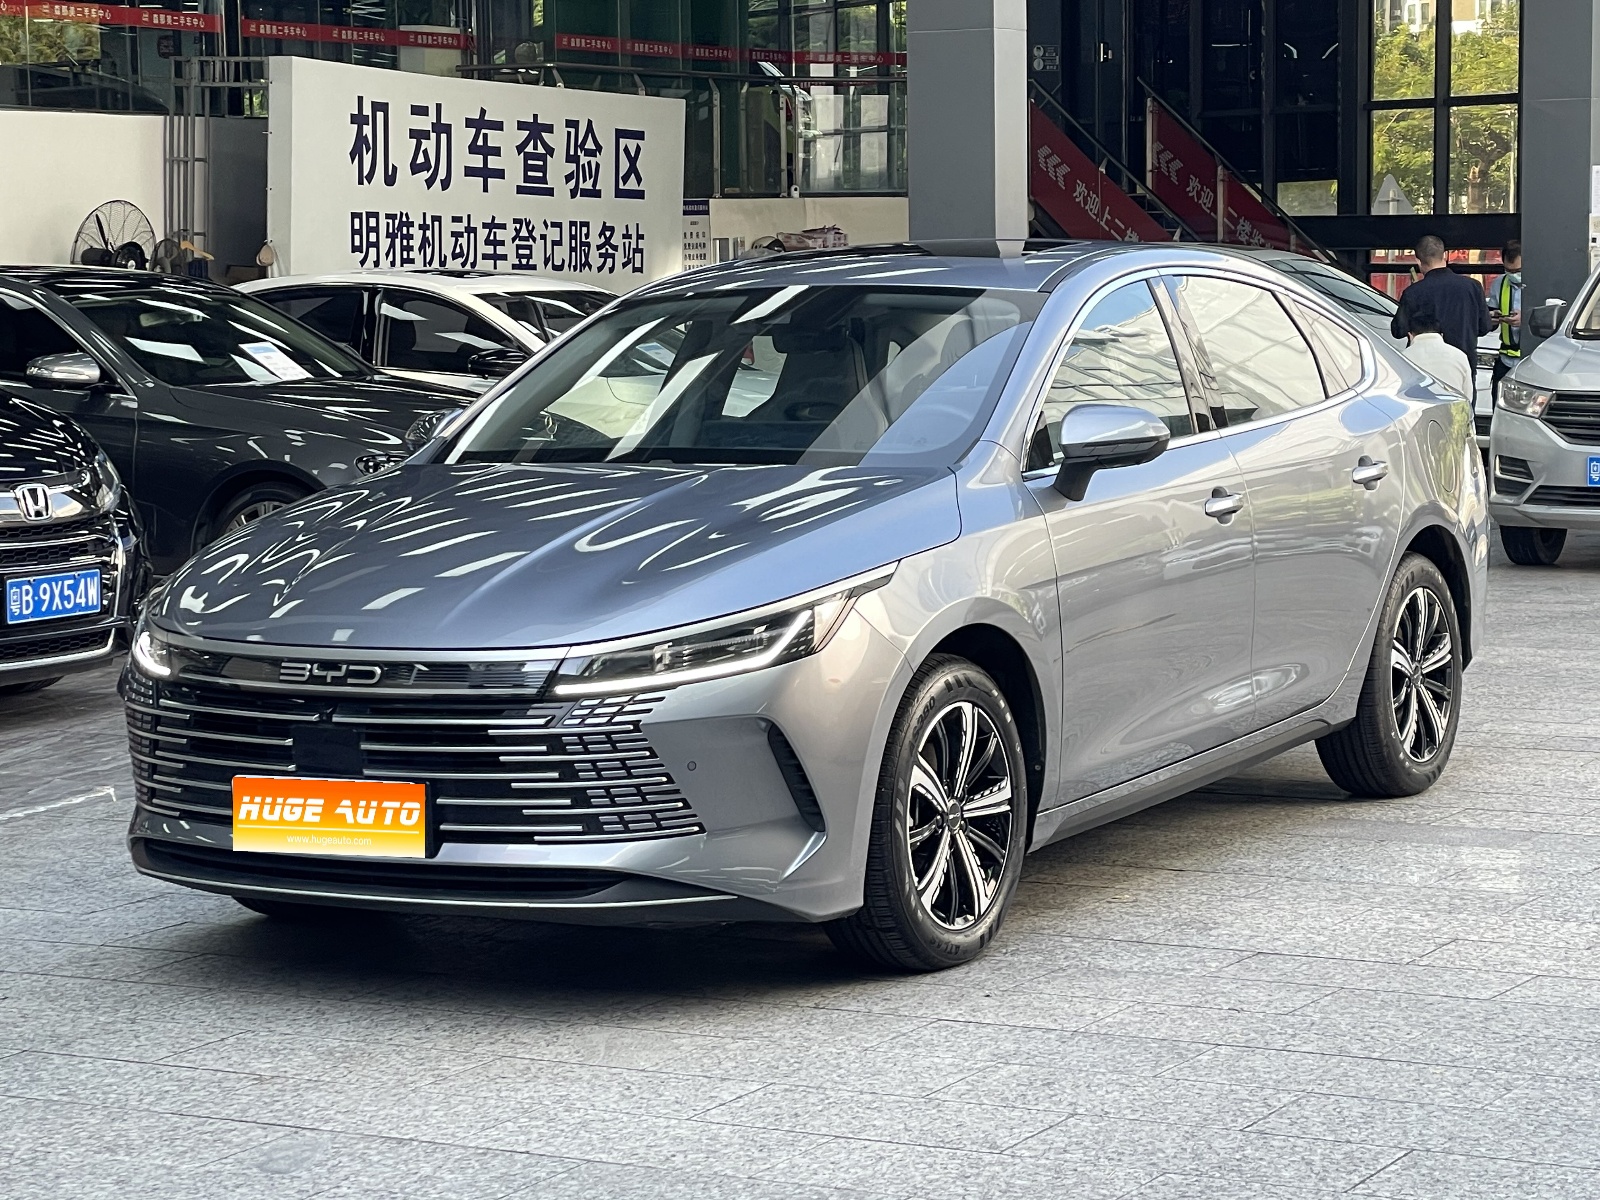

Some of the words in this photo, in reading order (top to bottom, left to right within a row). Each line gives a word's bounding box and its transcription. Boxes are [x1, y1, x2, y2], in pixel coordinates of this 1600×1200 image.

[349, 95, 646, 200] 机动车查验区
[350, 210, 645, 274] 明雅机动车登记服务站
[280, 661, 382, 685] BYD
